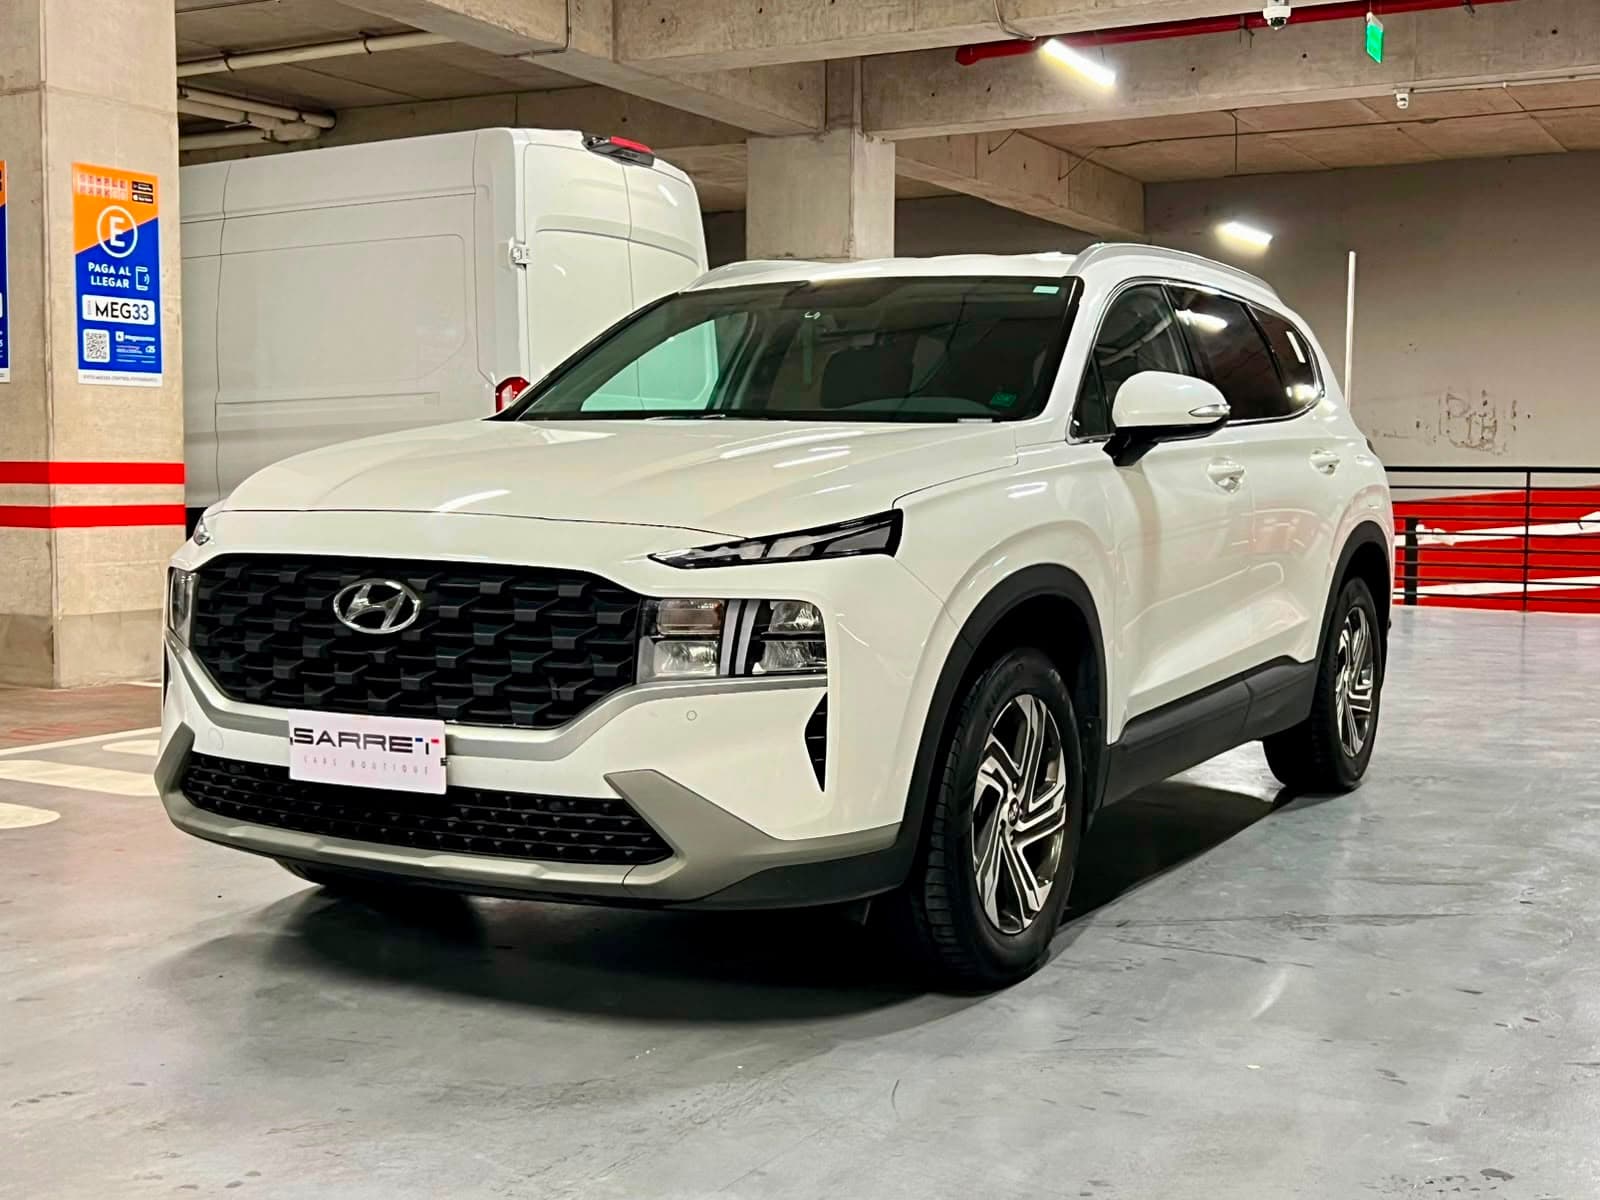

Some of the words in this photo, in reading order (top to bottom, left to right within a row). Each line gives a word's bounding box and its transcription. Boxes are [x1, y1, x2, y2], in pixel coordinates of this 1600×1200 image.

[88, 261, 116, 275] PAGA
[118, 266, 132, 276] AL
[91, 275, 130, 288] LLEGAR
[95, 301, 149, 321] MEG33
[304, 755, 337, 767] CARS
[351, 760, 429, 776] BOUTIQUE
